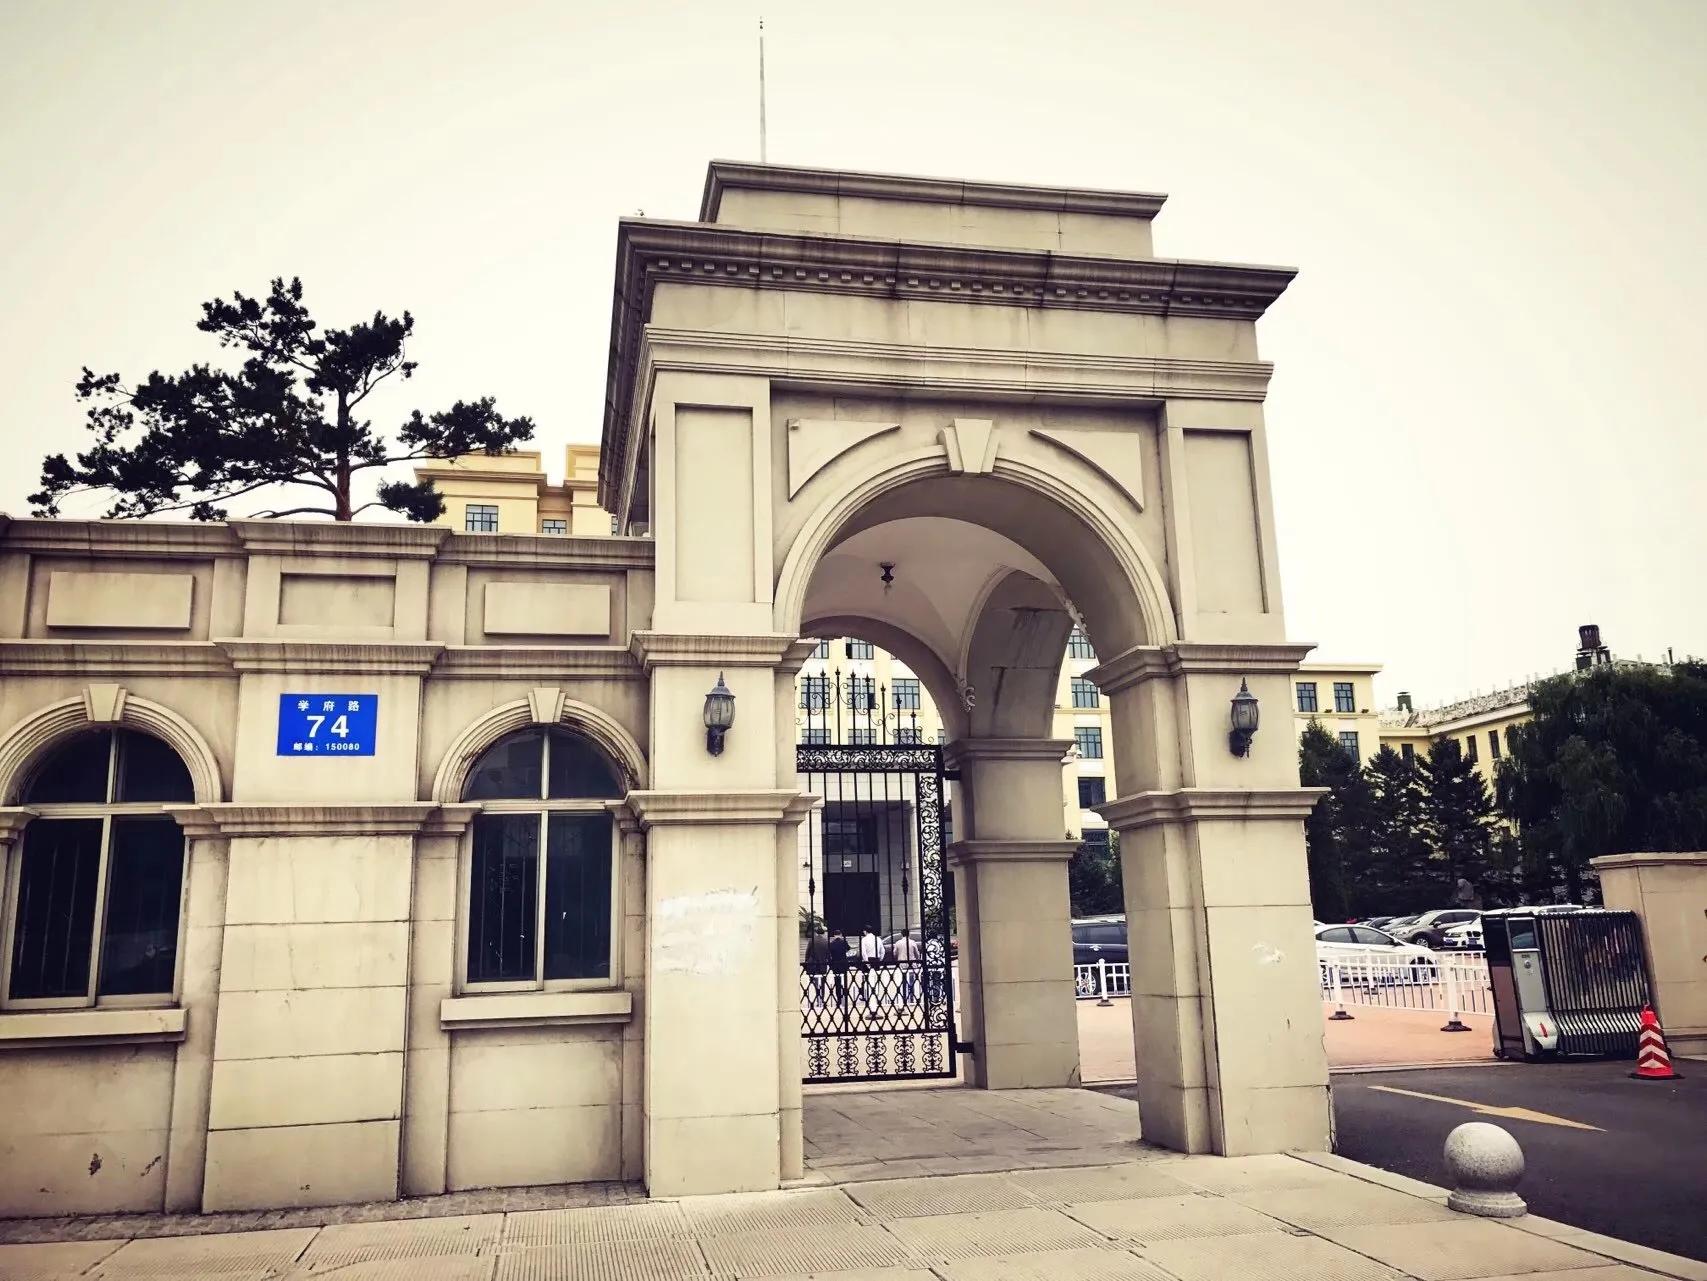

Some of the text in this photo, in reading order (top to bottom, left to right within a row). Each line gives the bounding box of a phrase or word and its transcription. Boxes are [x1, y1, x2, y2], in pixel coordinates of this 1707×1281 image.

[297, 699, 360, 712] 学府路
[306, 714, 350, 738] 74
[325, 742, 360, 751] 150080
